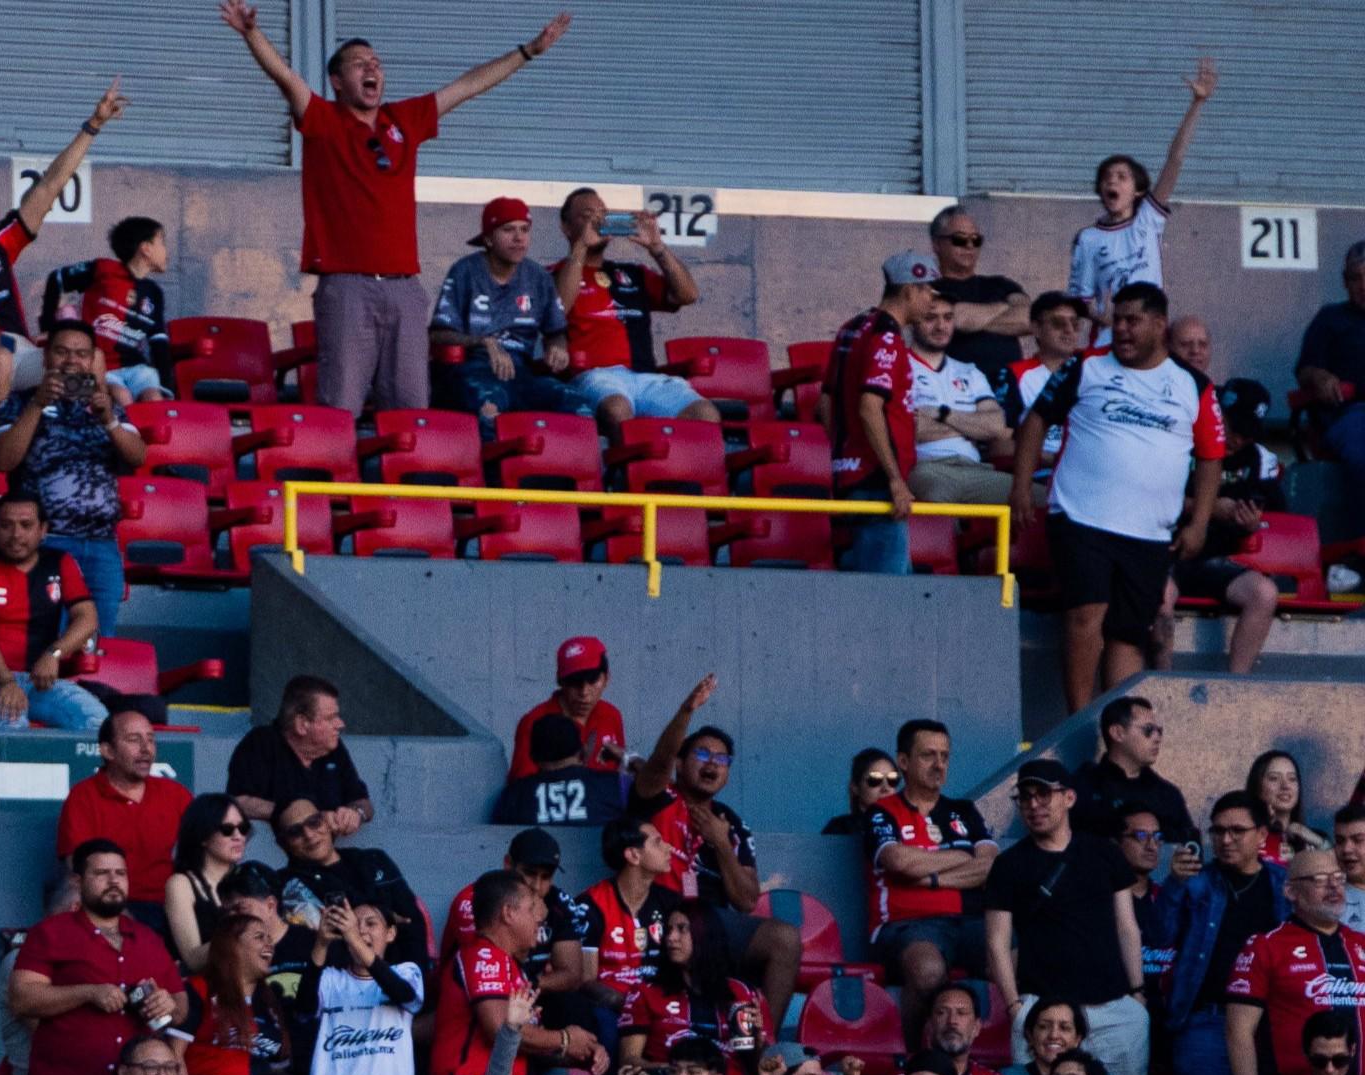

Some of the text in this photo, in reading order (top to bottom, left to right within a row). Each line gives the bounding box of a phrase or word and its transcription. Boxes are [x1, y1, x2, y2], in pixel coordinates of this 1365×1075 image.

[20, 168, 83, 212] 20
[648, 193, 714, 236] 212
[1250, 218, 1300, 259] 211
[76, 743, 101, 756] PUE
[536, 779, 588, 823] 152
[1305, 973, 1365, 999] Calien
[323, 1025, 405, 1053] Caliente
